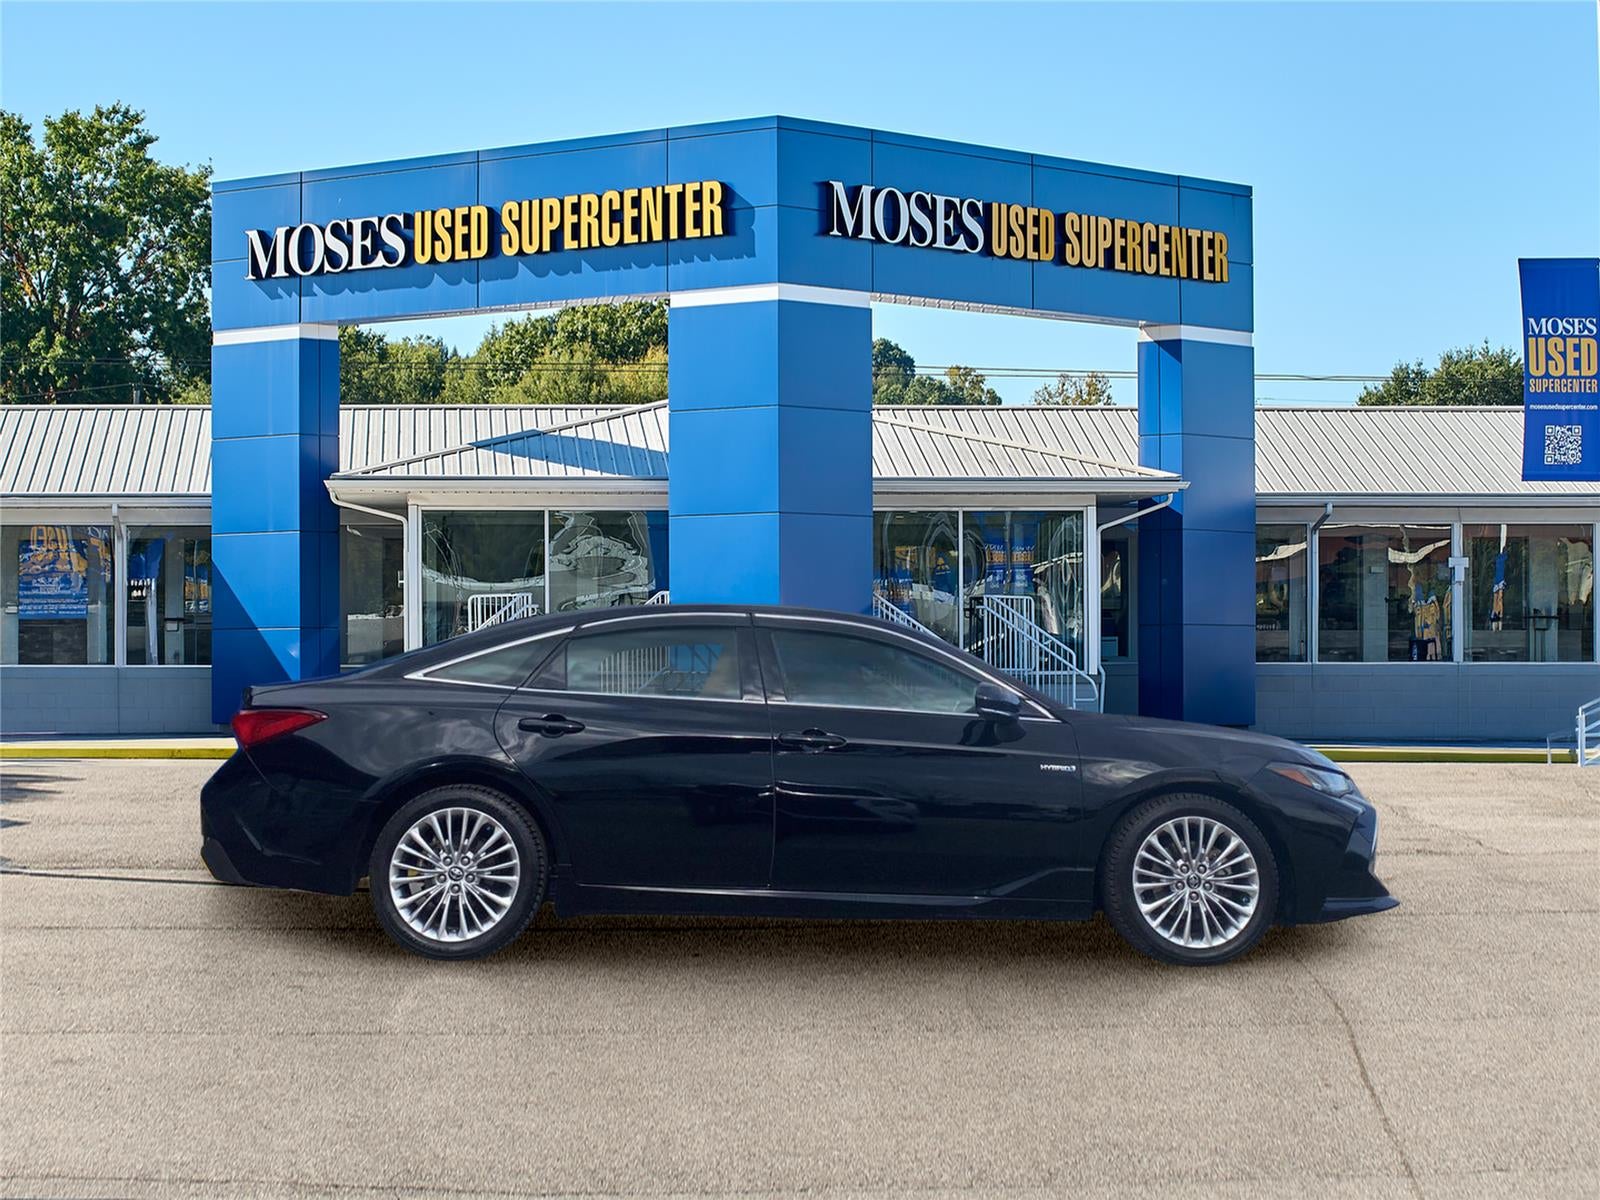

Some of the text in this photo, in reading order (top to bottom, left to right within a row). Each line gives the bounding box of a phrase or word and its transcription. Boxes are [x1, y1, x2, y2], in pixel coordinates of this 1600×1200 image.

[244, 180, 724, 281] MOSES USED SUPERCENTER
[828, 180, 1229, 283] MOSES USED SUPERCENTER
[1528, 317, 1598, 336] MOSES
[1528, 337, 1598, 377] USED
[1529, 379, 1598, 393] SUPERCENTER
